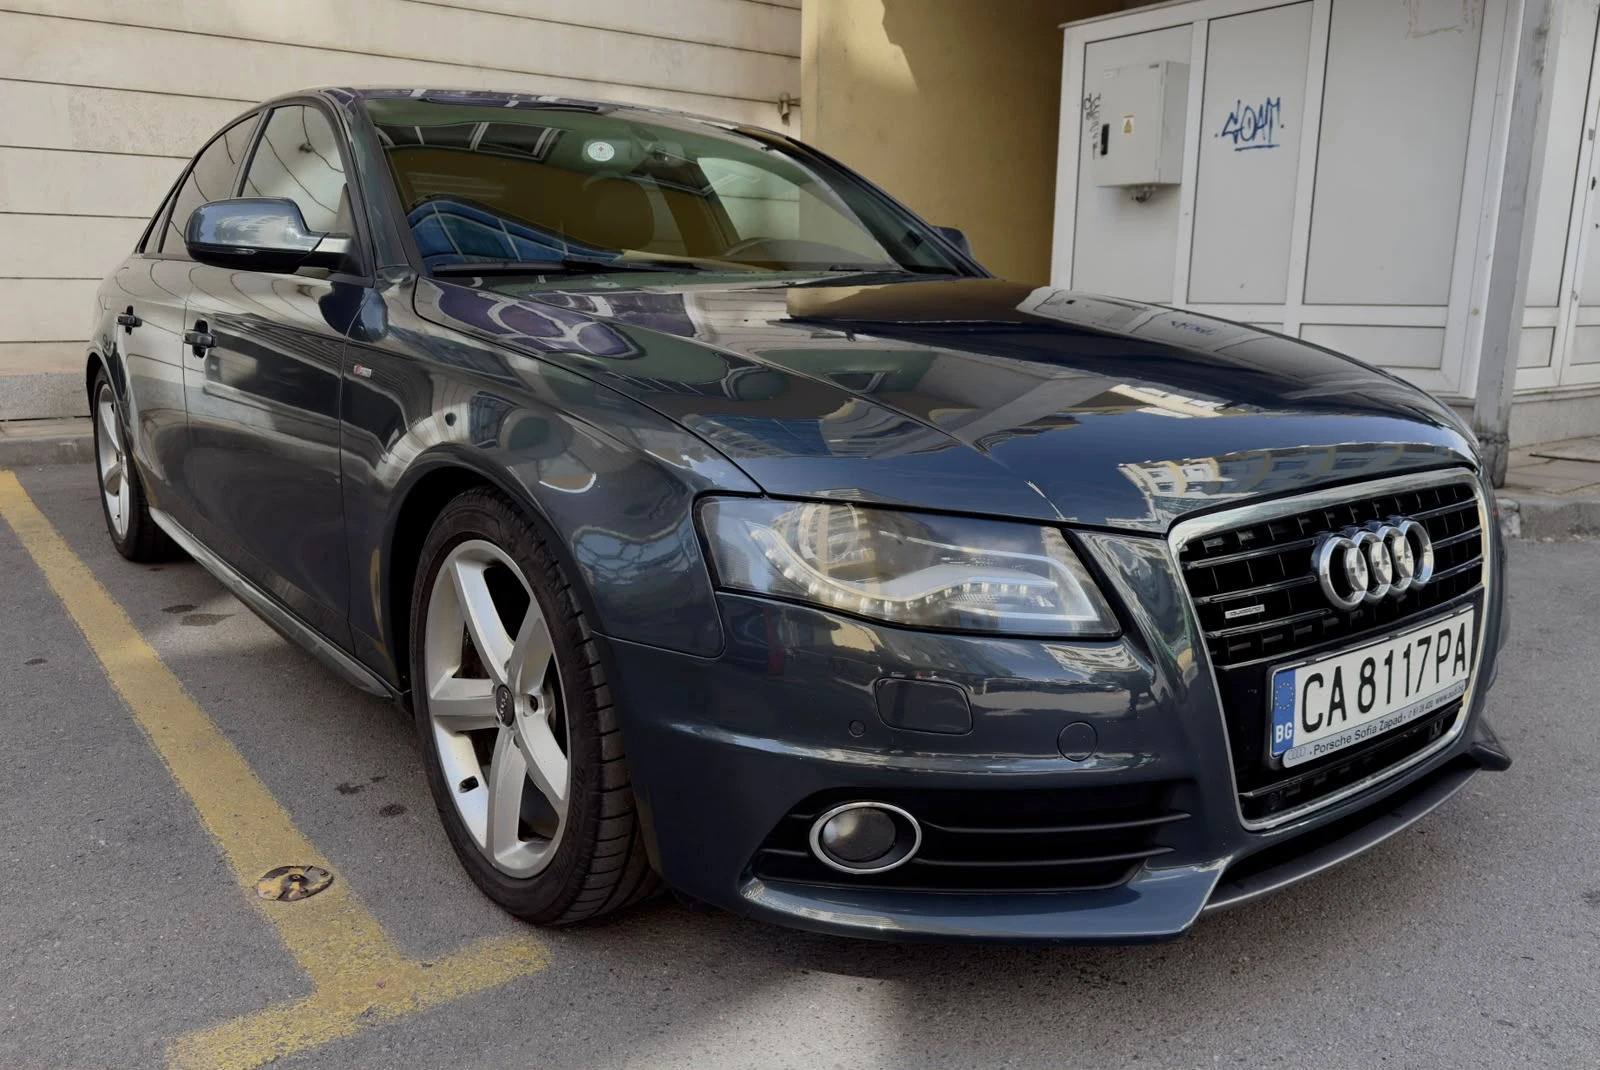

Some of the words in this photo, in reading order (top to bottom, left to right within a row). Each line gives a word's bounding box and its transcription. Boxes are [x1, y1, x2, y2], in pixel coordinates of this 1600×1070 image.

[1275, 722, 1293, 744] BG
[1313, 735, 1352, 756] Porsche
[1354, 724, 1378, 741] Sofia
[1379, 715, 1403, 731] Zapad
